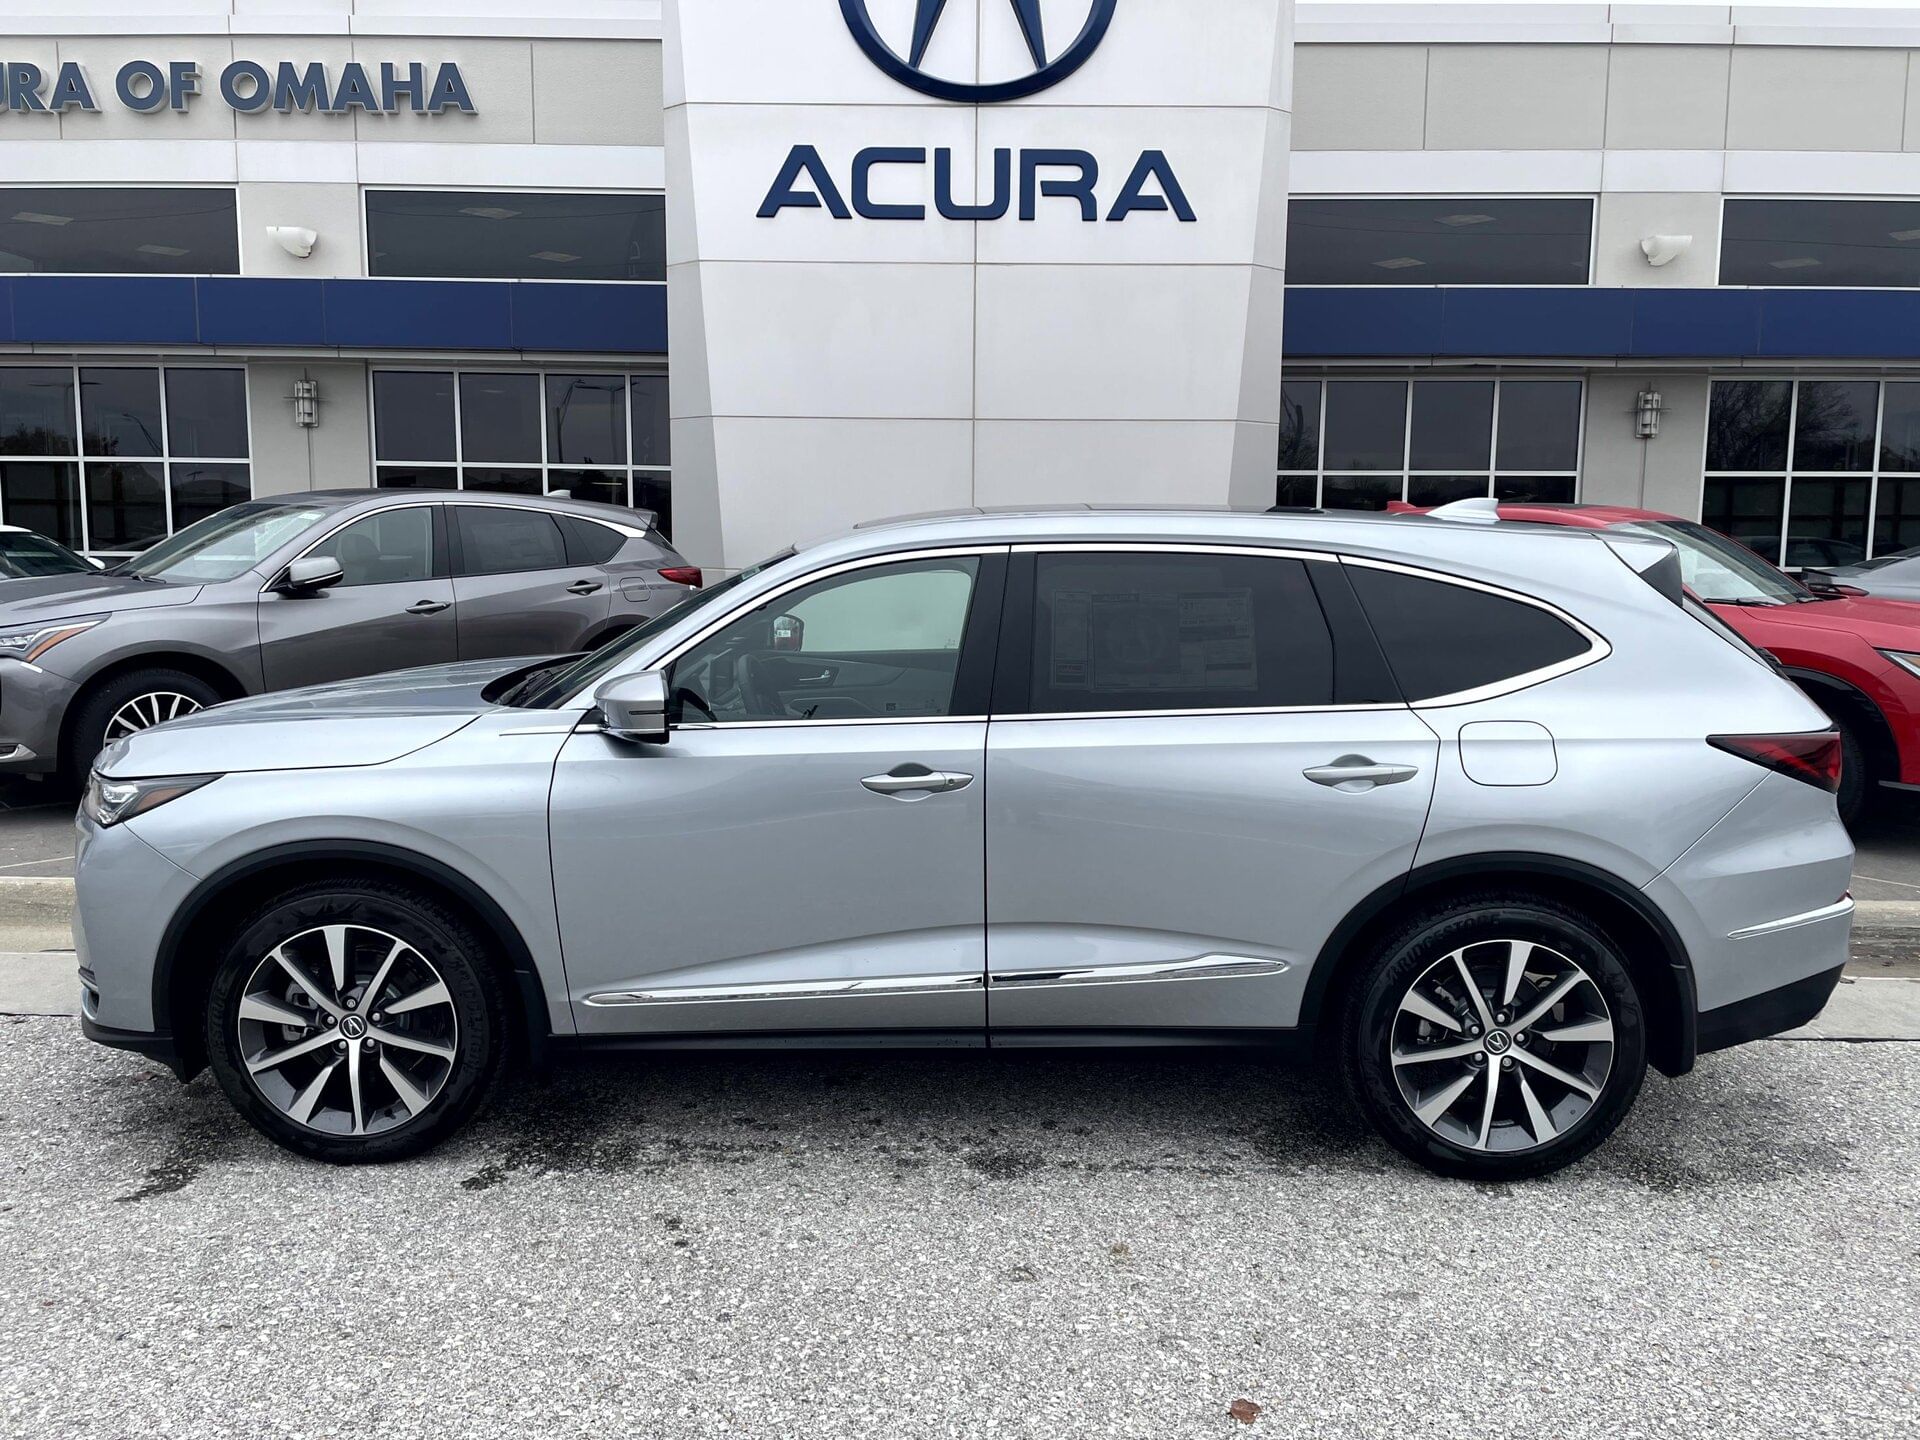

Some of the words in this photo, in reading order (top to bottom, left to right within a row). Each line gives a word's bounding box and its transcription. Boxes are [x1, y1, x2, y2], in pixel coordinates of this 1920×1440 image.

[0, 61, 97, 112] RA
[115, 60, 199, 113] OF
[219, 60, 477, 114] OMAHA
[756, 144, 1197, 221] ACURA
